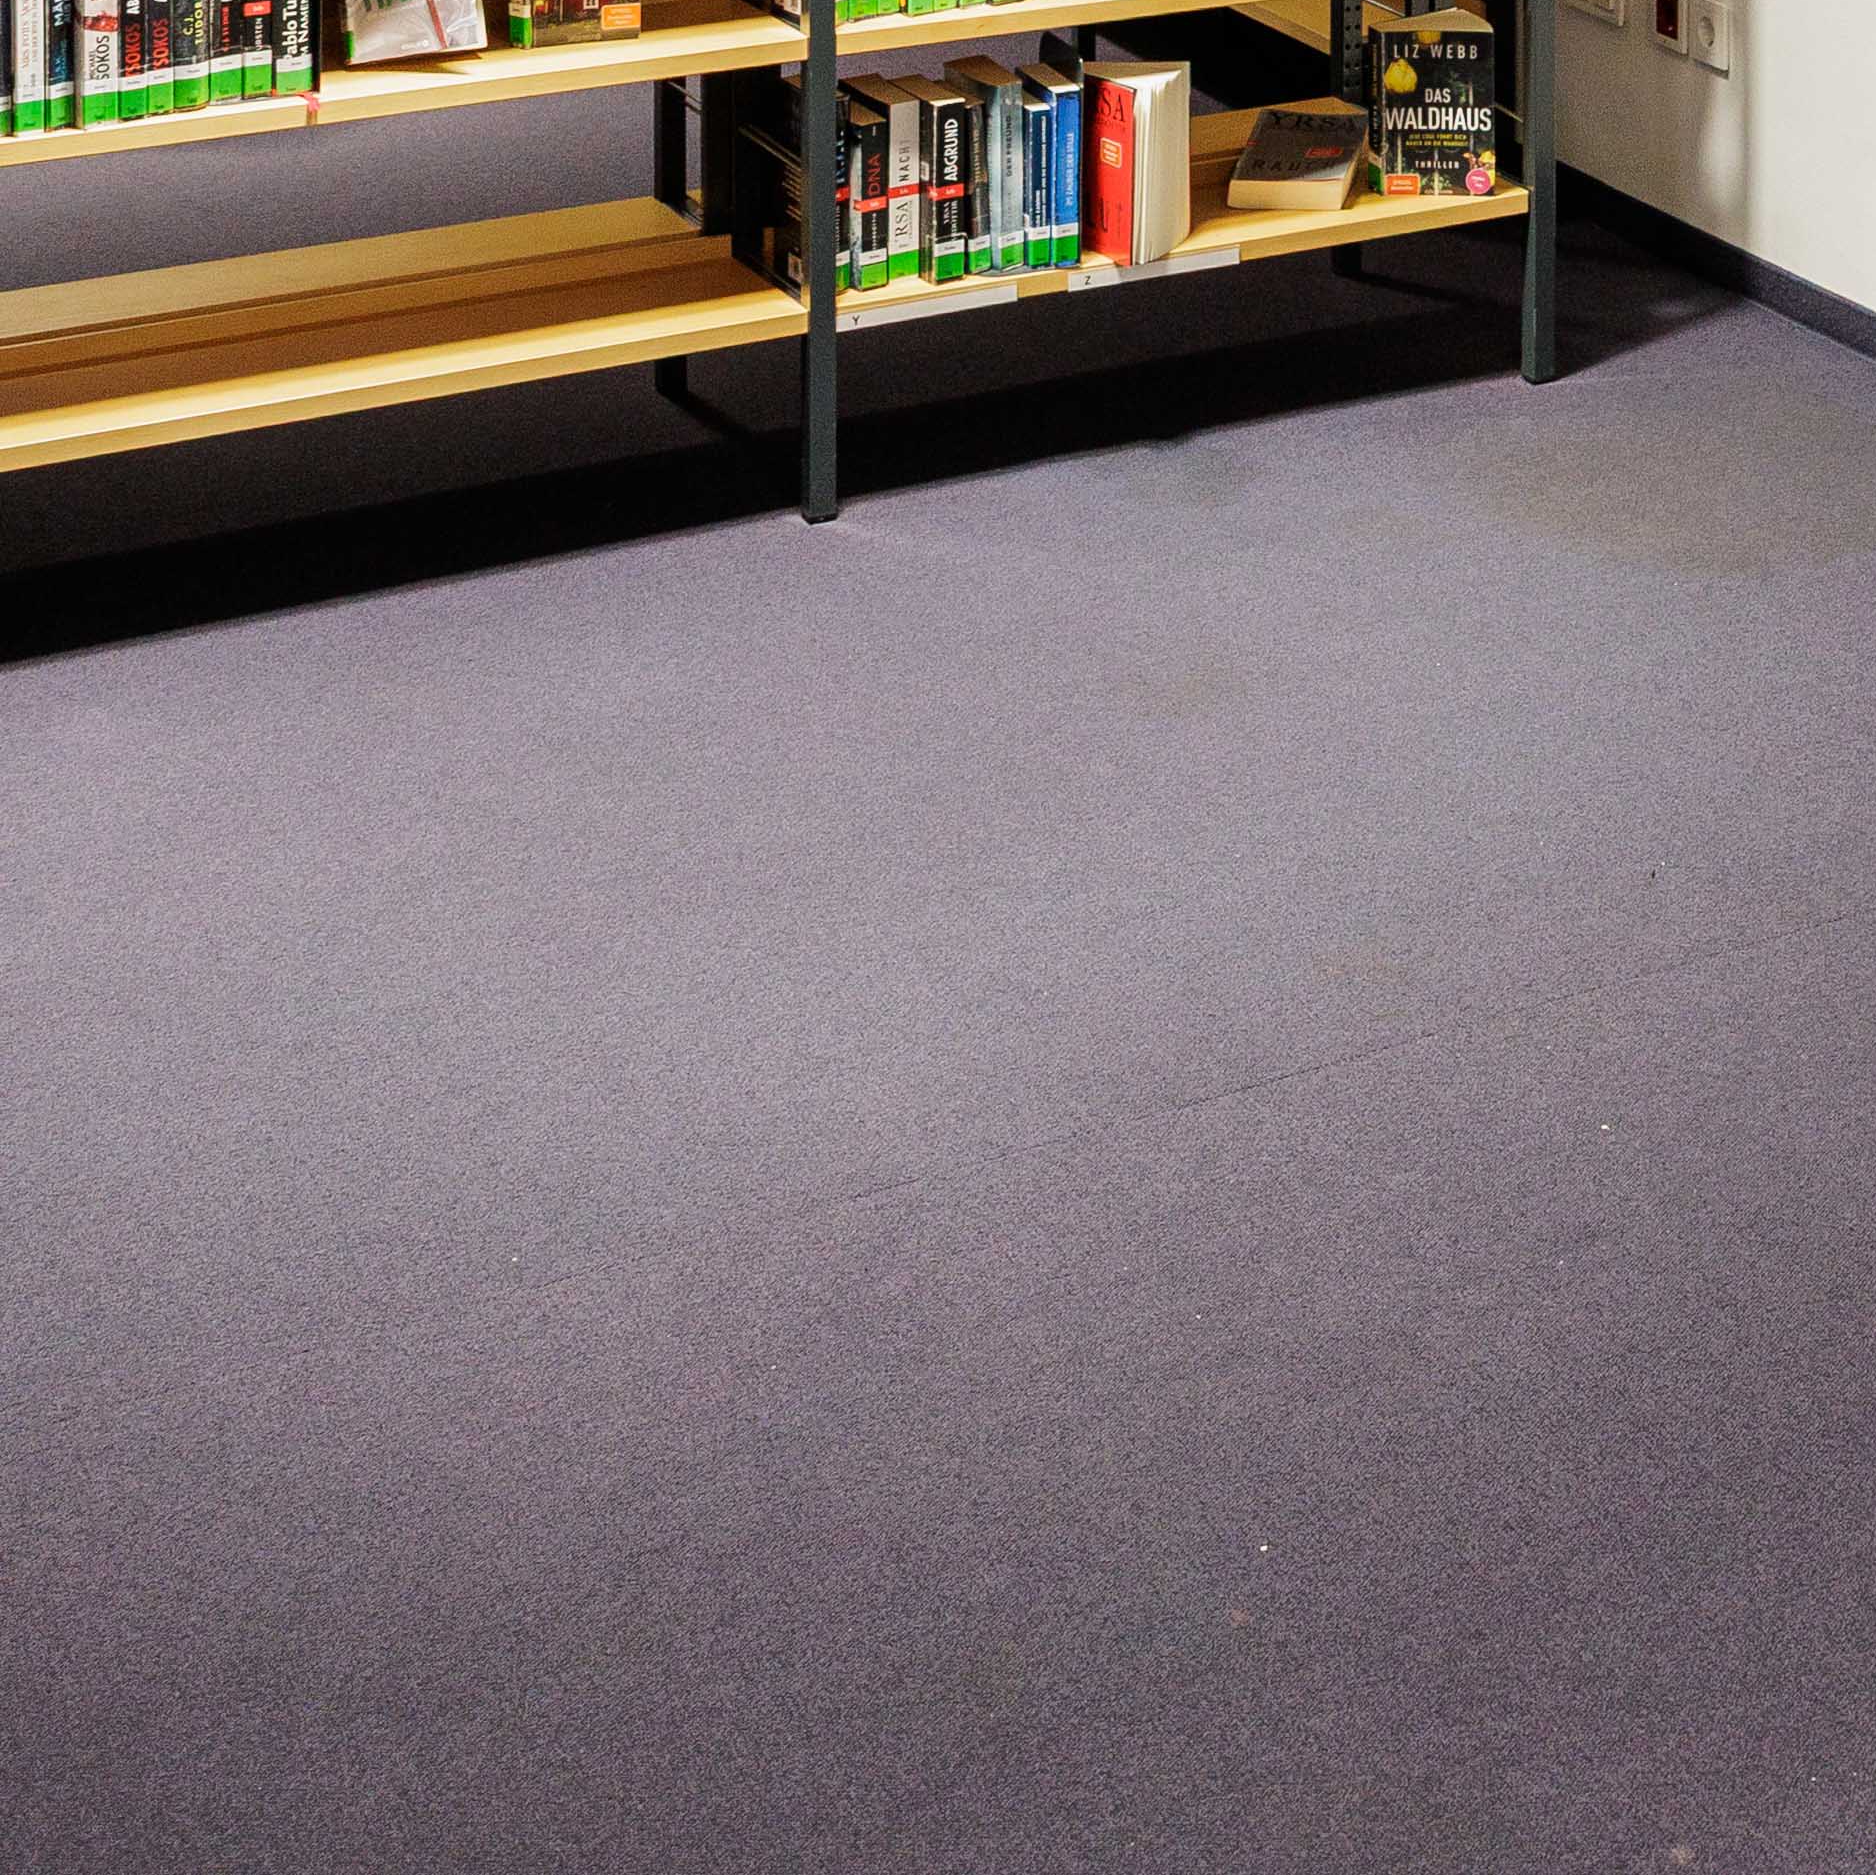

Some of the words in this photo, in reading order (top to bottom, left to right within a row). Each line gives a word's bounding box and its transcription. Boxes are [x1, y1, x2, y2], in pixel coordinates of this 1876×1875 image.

[1393, 44, 1420, 60] LIZ
[1430, 43, 1479, 60] WEBB
[1425, 87, 1451, 104] DAS
[1386, 106, 1492, 133] WALDHAUS
[943, 119, 959, 181] ABGRUND
[1415, 159, 1460, 170] THRILLER
